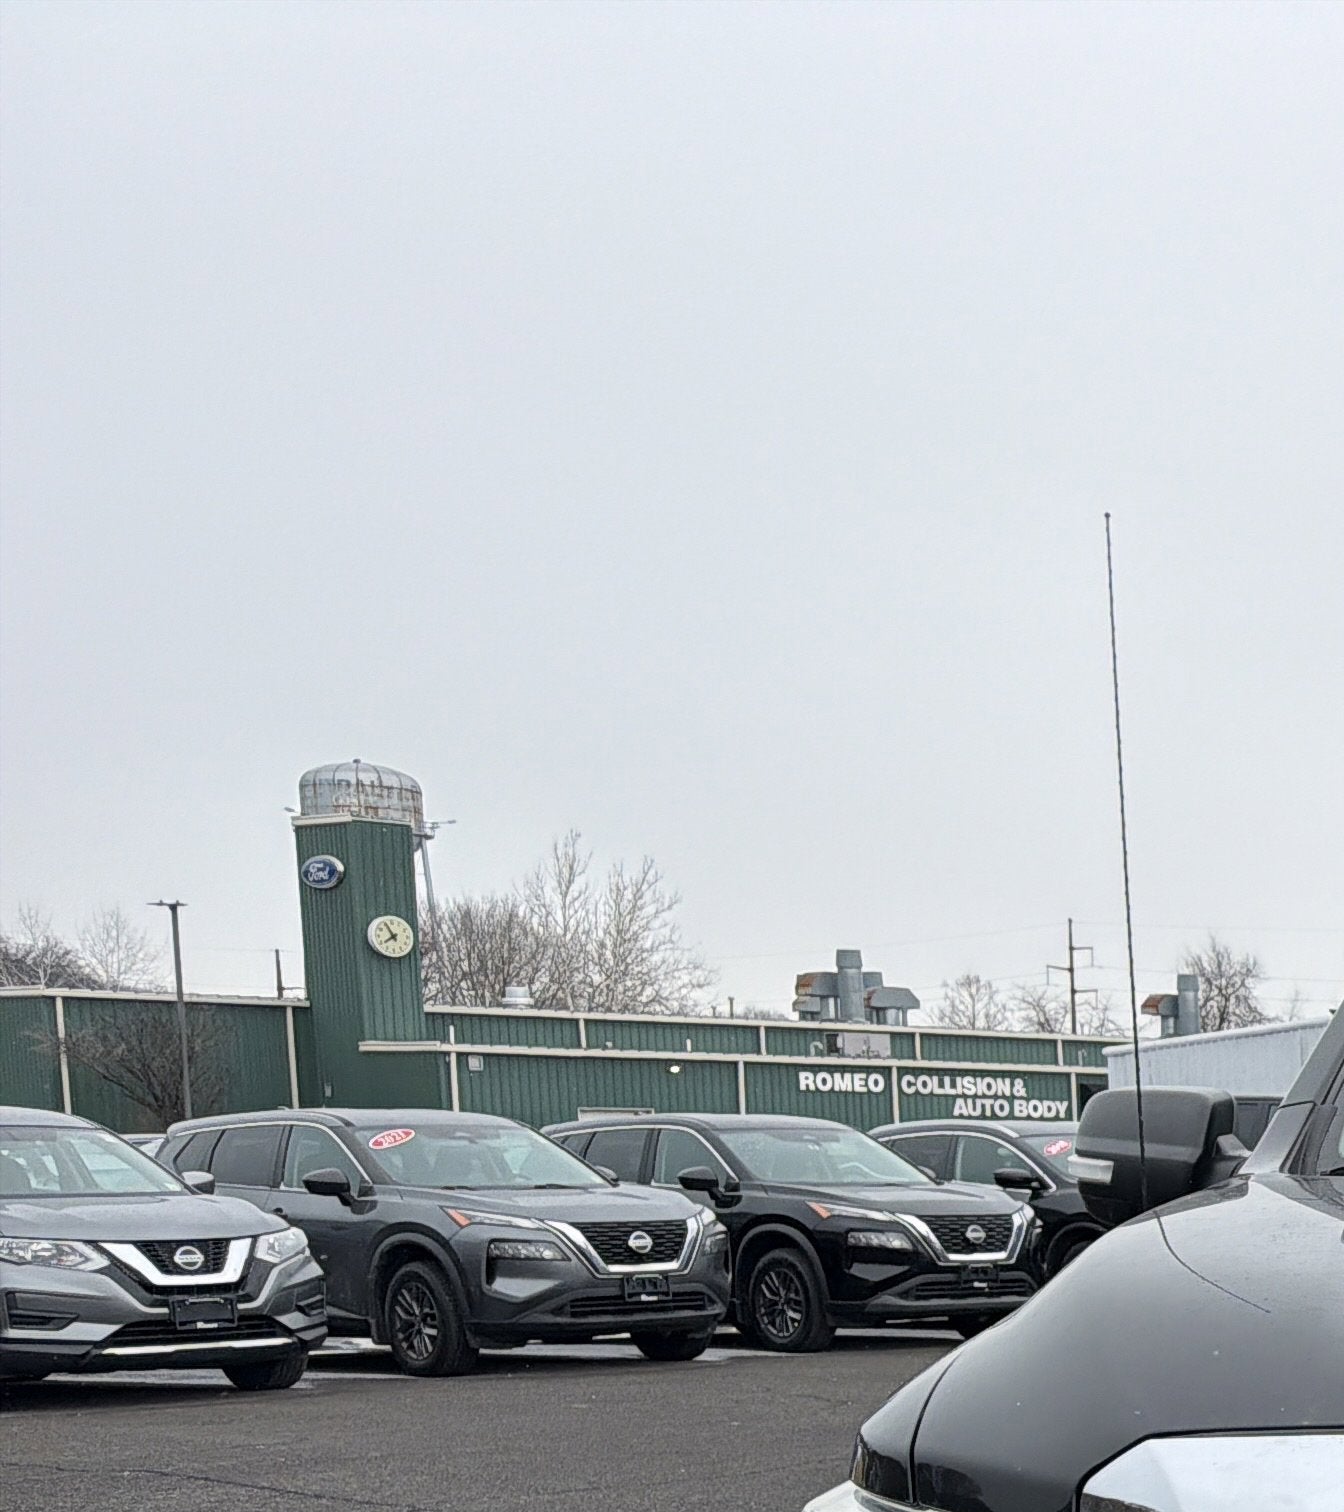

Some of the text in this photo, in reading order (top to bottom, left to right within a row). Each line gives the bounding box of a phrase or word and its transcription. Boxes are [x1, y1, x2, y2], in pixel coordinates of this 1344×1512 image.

[308, 863, 330, 882] Ford
[799, 1071, 1028, 1098] ROMEO COLLISION &
[953, 1098, 1069, 1119] AUTO BODY
